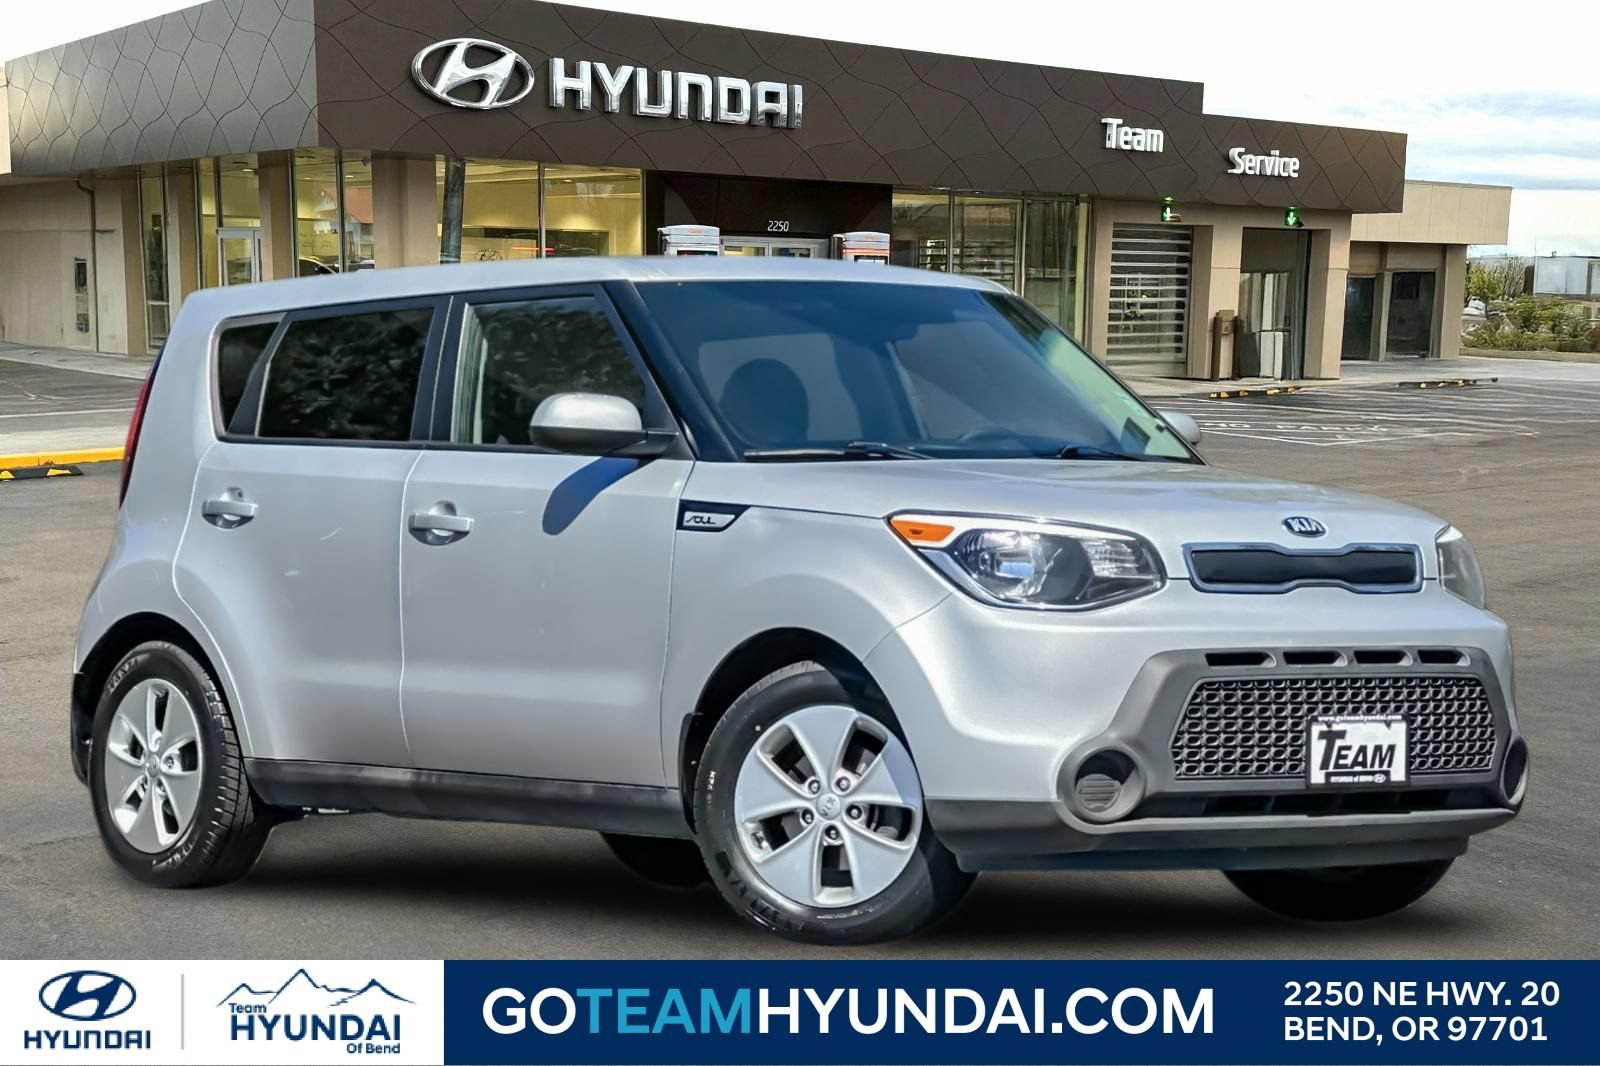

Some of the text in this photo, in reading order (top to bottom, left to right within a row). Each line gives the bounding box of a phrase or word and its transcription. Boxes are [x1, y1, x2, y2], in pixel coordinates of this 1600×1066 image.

[549, 57, 802, 129] HYUNDAI
[1101, 117, 1164, 153] Team
[1227, 147, 1300, 178] Service
[767, 220, 790, 232] 2250
[1286, 517, 1324, 532] KIA
[1317, 729, 1397, 772] TEAM
